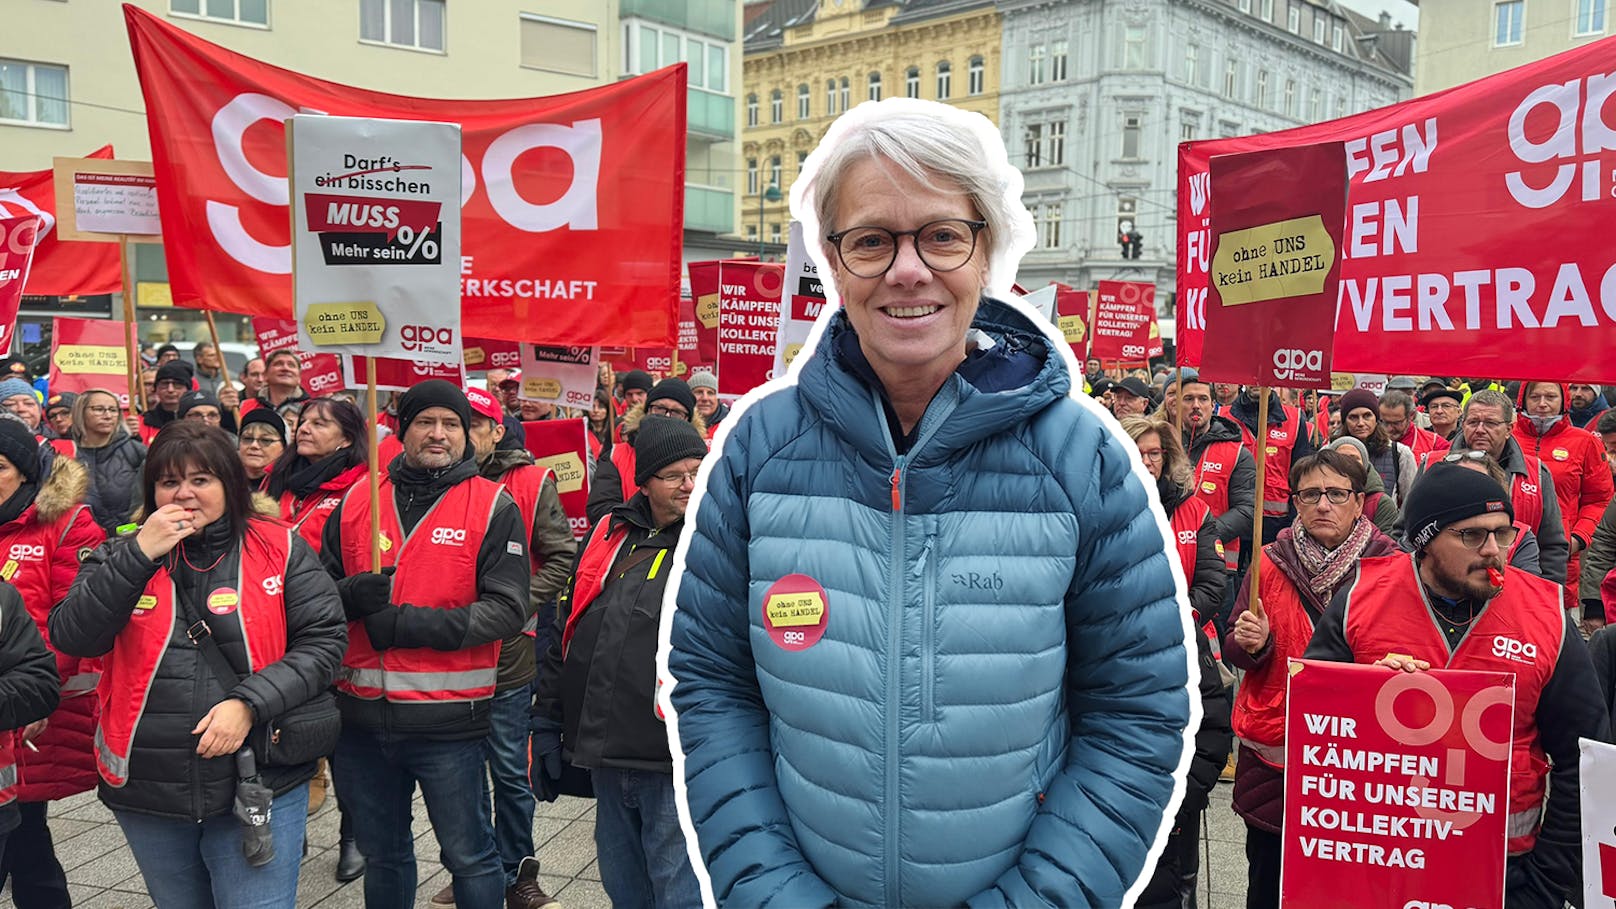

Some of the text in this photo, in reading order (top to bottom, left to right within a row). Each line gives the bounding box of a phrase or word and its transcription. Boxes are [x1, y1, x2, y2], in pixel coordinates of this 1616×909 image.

[315, 173, 430, 194] ein bisschen
[326, 202, 400, 229] MUSS
[397, 226, 438, 260] %
[1233, 235, 1306, 263] ohne UNS
[331, 243, 406, 260] Mehr sein
[1218, 255, 1325, 287] kein HANDEL
[722, 285, 747, 296] WIR
[721, 298, 781, 312] KÄMPFEN
[1100, 303, 1136, 312] KÄMPFEN
[319, 310, 369, 321] ohne UNS
[721, 311, 781, 327] FÜR UNSE
[1099, 311, 1150, 322] FÜR UNSEREN
[309, 322, 380, 334] kein HANDEL
[720, 329, 778, 342] KOLLEKT
[400, 325, 452, 351] gpa
[491, 351, 519, 366] gpa
[538, 351, 558, 360] Mehr
[1122, 345, 1145, 356] gpa
[646, 357, 671, 370] gpa
[1272, 348, 1323, 380] gpa
[309, 372, 338, 392] gpa
[467, 391, 492, 406] gpa
[566, 390, 591, 404] gpa
[1270, 429, 1288, 439] gpa
[555, 461, 571, 472] UNS
[1201, 461, 1223, 473] gpa
[431, 527, 466, 546] gpa
[9, 544, 45, 560] gpa
[968, 572, 1003, 590] Rab
[791, 608, 820, 616] HANDEL
[784, 631, 804, 643] gpa
[1492, 635, 1537, 659] gpa
[1304, 714, 1357, 738] WIR
[1303, 743, 1438, 777] KÄMPFEN
[1302, 773, 1495, 814] FÜR UNSEREN
[1301, 806, 1463, 840] KOLLEKTIV-
[1299, 836, 1425, 869] VERTRAG
